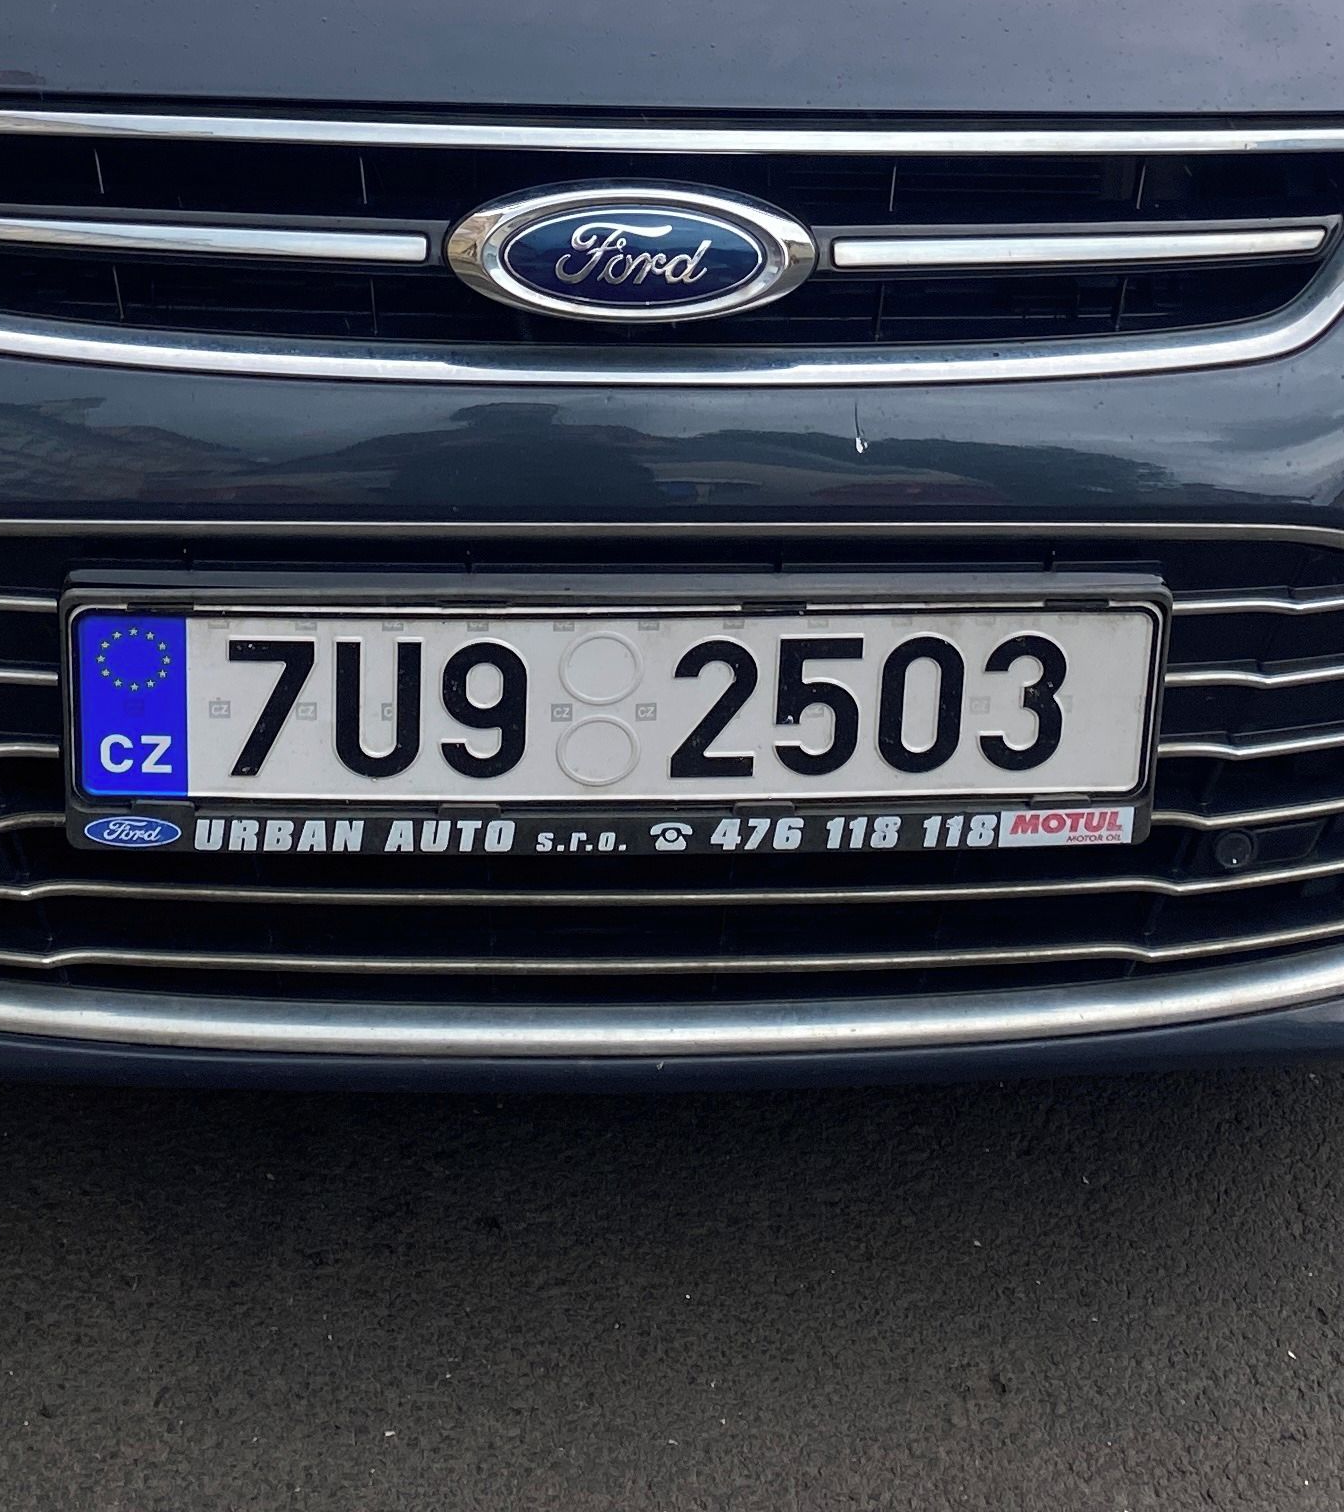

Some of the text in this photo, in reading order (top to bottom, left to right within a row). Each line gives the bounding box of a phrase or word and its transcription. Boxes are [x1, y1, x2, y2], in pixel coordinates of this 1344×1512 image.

[555, 221, 713, 285] Ford
[226, 633, 1068, 779] 7U9 2503
[100, 734, 173, 774] CZ
[102, 819, 162, 842] Ford
[193, 814, 998, 853] URBAN AUTO s.r.o. 476 118 118
[1009, 810, 1123, 835] MOTUL
[1066, 833, 1104, 844] MOTOR
